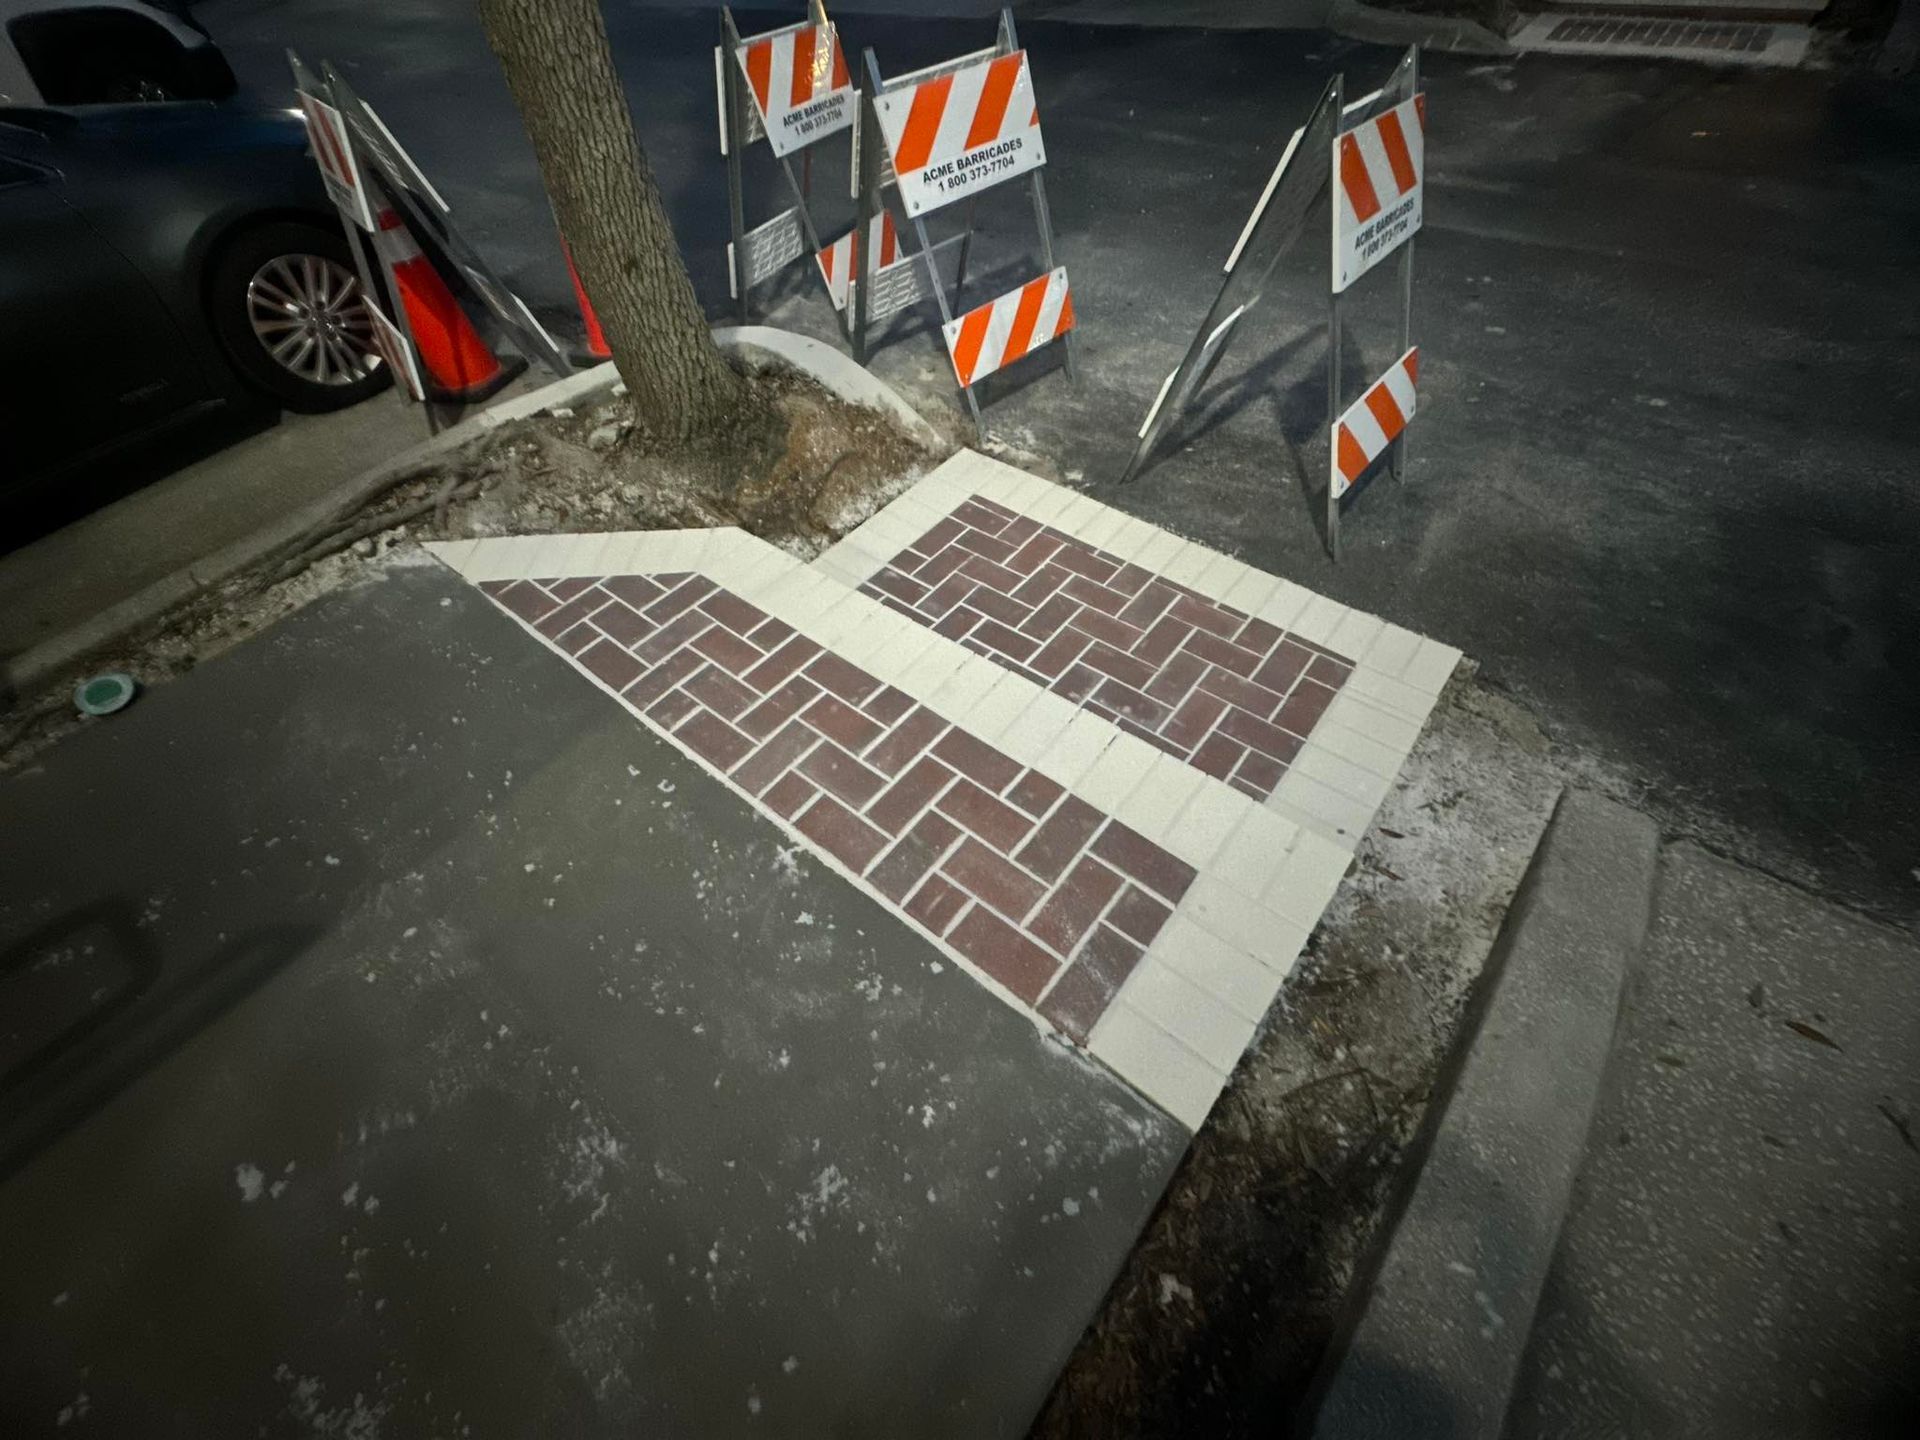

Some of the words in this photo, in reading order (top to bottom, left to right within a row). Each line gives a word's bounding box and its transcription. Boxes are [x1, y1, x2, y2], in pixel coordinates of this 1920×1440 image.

[783, 110, 804, 127] ACME
[804, 94, 845, 118] BARRICADES
[795, 125, 800, 135] 1
[923, 162, 955, 183] ACME
[957, 138, 1023, 171] BARRICADES
[938, 180, 945, 191] 1
[947, 174, 968, 189] 800
[969, 155, 1015, 181] 373-7704
[1354, 225, 1375, 250] ACME
